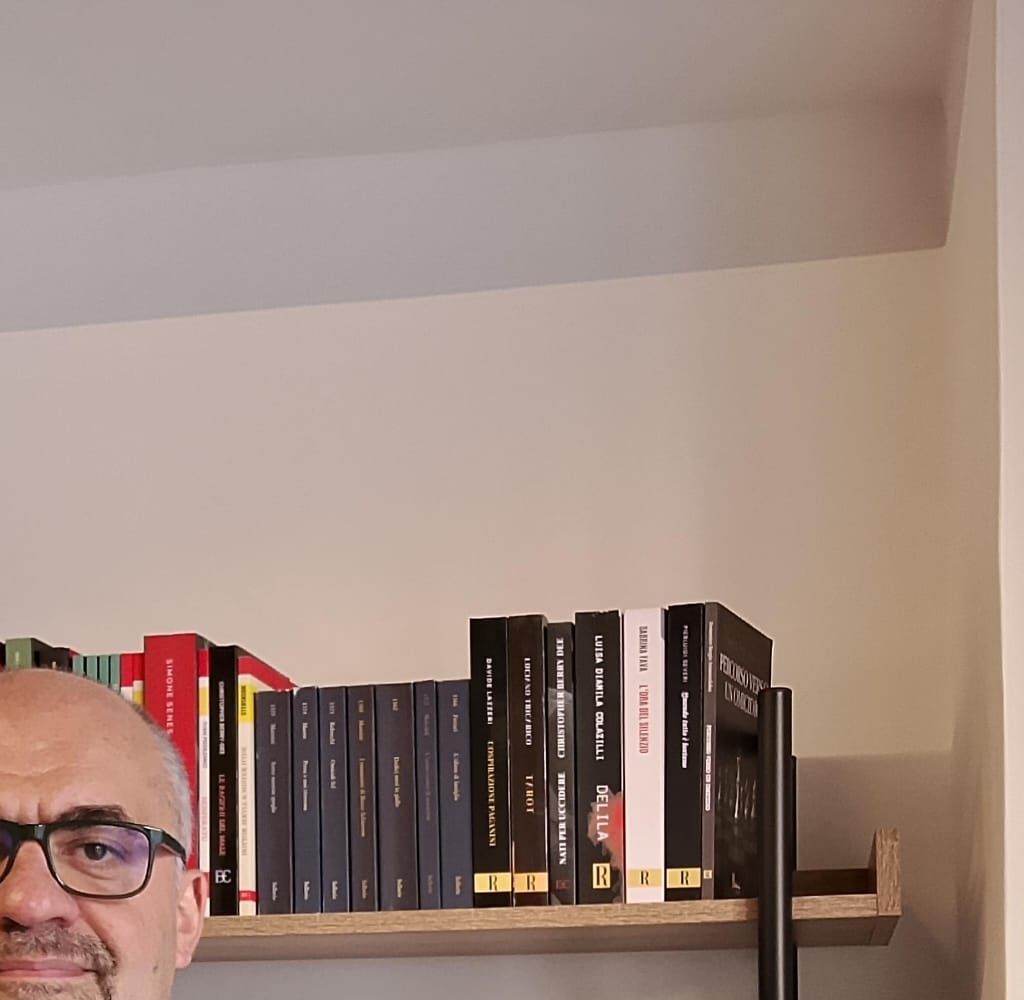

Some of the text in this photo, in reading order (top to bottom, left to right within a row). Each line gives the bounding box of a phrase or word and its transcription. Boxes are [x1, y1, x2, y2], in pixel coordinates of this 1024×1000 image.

[595, 635, 604, 664] LUISA
[639, 626, 648, 654] SABRINA
[166, 658, 174, 698] SIMONE
[524, 657, 532, 696] LUCIANO
[556, 691, 565, 759] CHRISTOPHER
[639, 707, 648, 720] DEL
[639, 722, 648, 754] SILENZIO
[487, 741, 497, 847] COSPIRAZIONE PAGANINI
[557, 771, 567, 865] NATI PER UCCIDERE
[596, 784, 609, 842] DELILA
[596, 865, 607, 887] R
[640, 870, 649, 886] R
